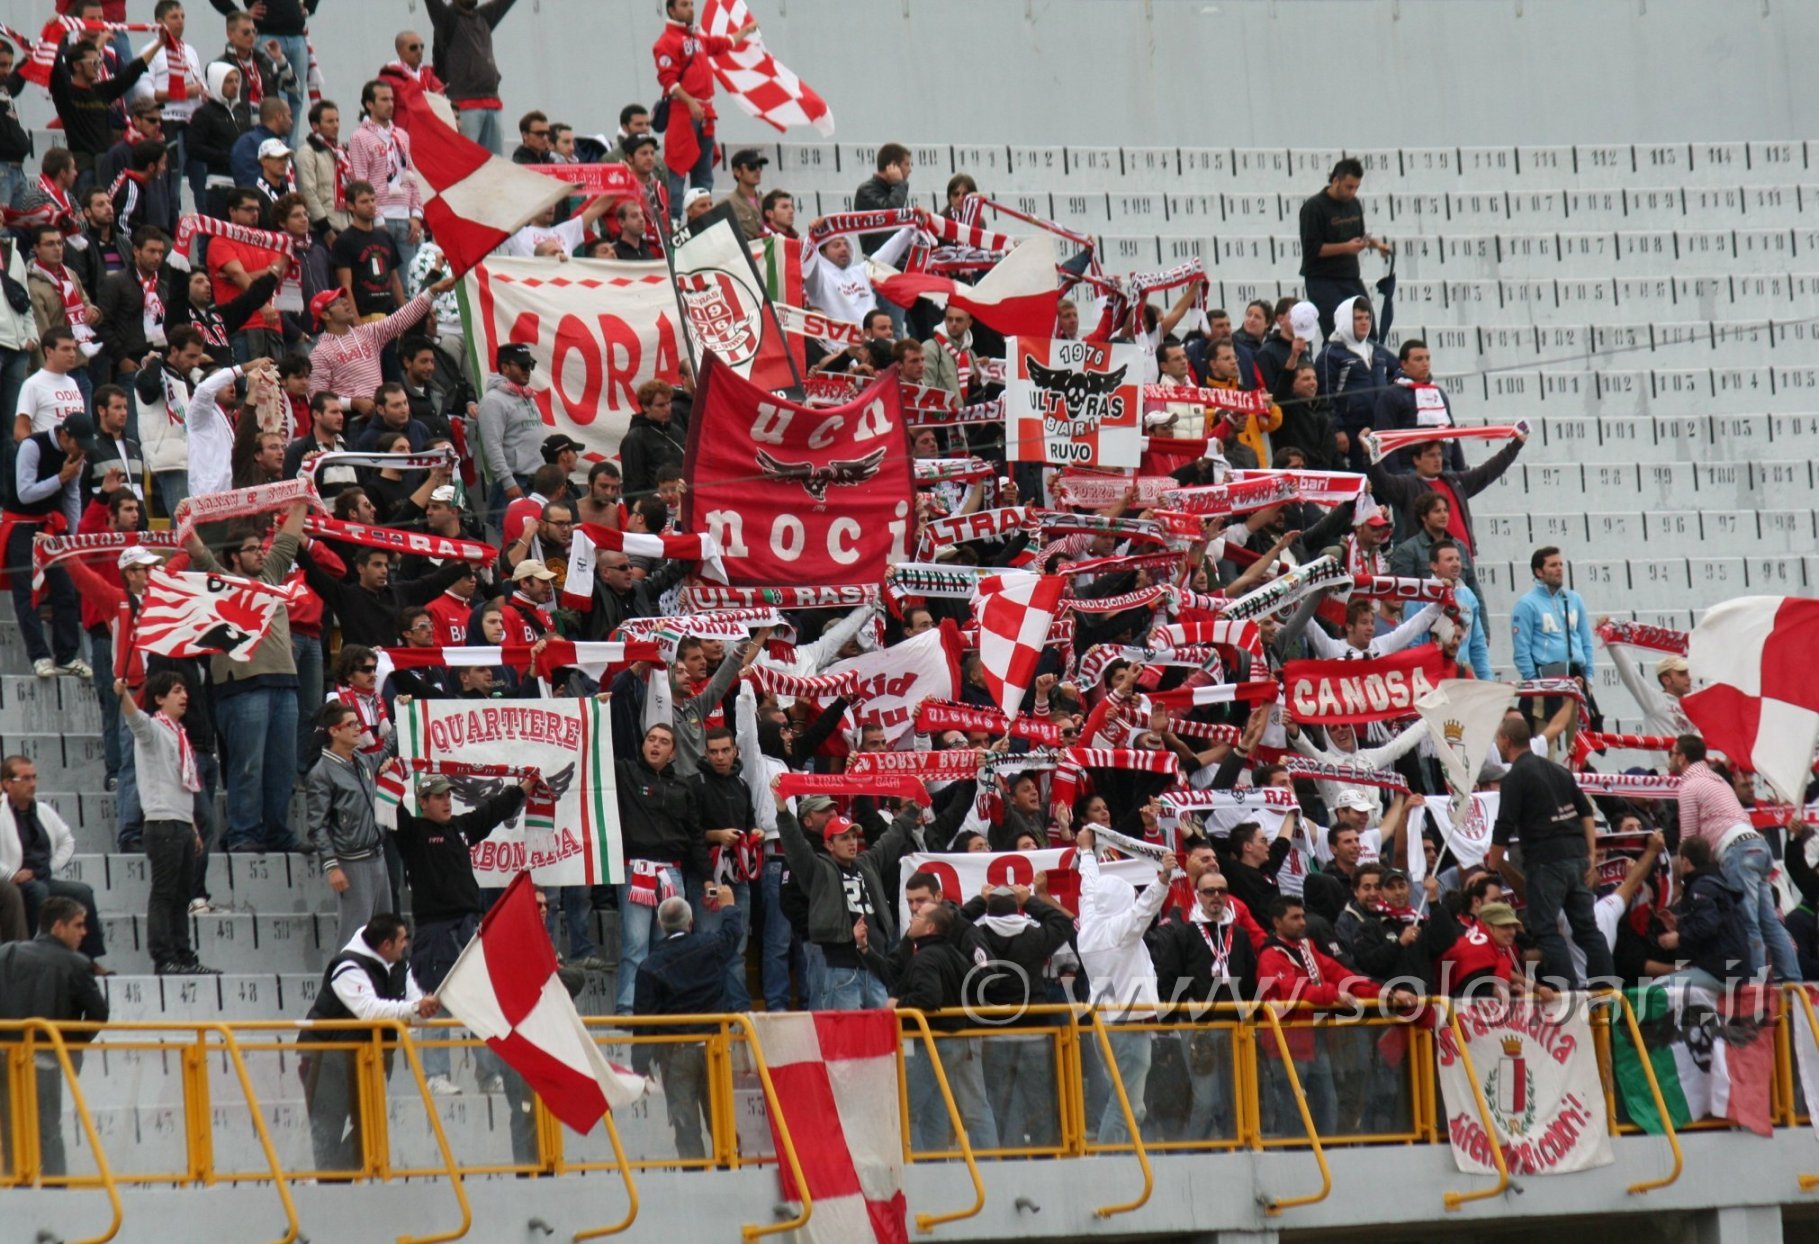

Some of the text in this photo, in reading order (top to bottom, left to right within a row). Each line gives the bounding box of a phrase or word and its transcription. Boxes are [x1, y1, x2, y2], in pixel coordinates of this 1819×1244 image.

[672, 228, 692, 249] CN
[1060, 343, 1104, 365] 1976
[1045, 416, 1096, 436] BARI
[1050, 443, 1091, 461] RUVO
[1300, 476, 1329, 491] bari
[705, 500, 911, 565] noci
[900, 568, 968, 593] ULTRAS
[1293, 666, 1435, 717] CANOSA
[431, 707, 581, 753] QUARTIERE
[1264, 790, 1300, 806] RA
